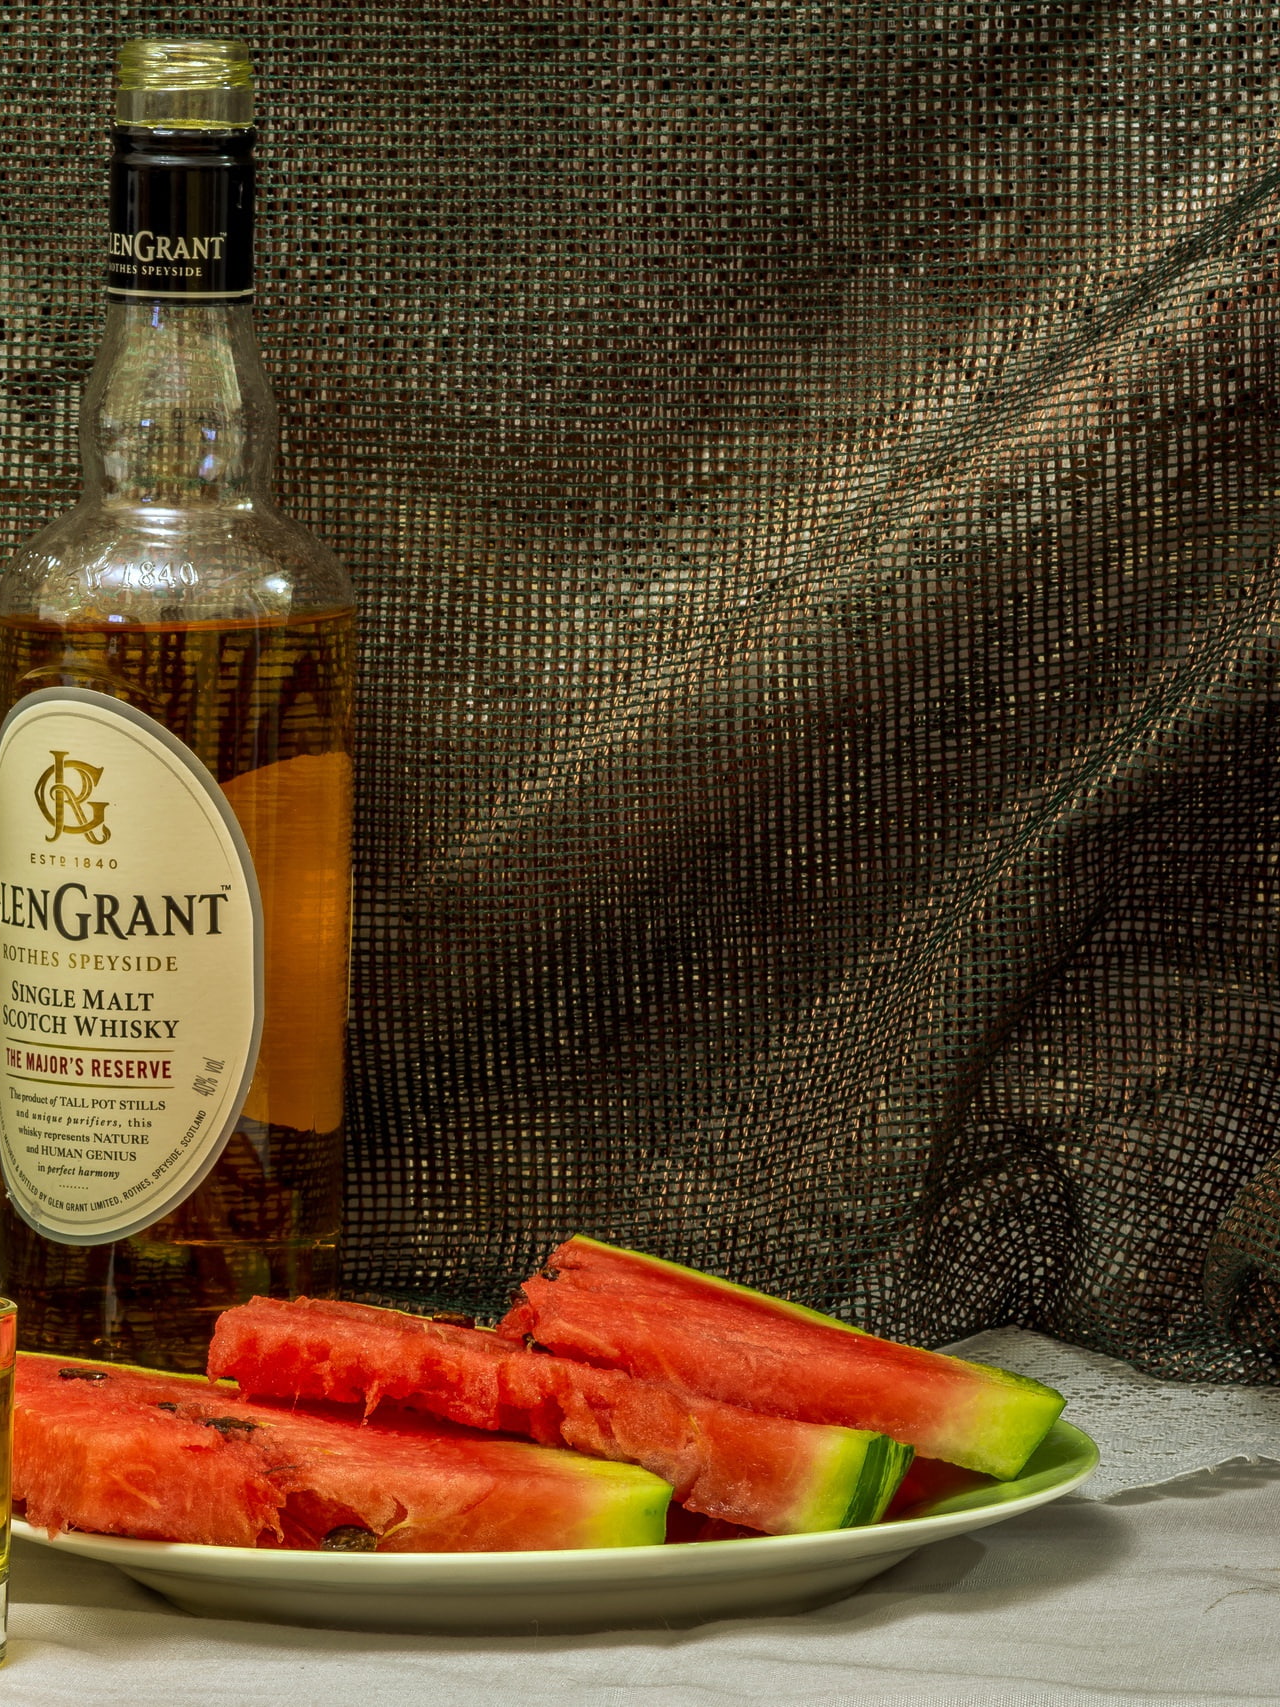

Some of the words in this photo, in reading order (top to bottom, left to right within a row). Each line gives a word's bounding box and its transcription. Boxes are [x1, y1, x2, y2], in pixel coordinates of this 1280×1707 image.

[109, 230, 224, 262] LENGRANT
[109, 263, 137, 275] OTHES
[141, 265, 202, 277] SPEYSIDE
[118, 560, 199, 590] 1840
[74, 856, 119, 870] 1840
[3, 943, 59, 967] ROTHES
[69, 953, 178, 972] SPEYSIDE
[11, 980, 76, 1009] SINGLE
[83, 989, 154, 1012] MALT
[3, 1004, 67, 1035] SCOTCH
[74, 1015, 179, 1039] WHISKY
[6, 1047, 22, 1069] THE
[26, 1051, 84, 1076] MAJOR'S
[91, 1060, 172, 1079] RESERVE
[192, 1075, 218, 1096] 40%
[9, 1086, 21, 1100] The
[21, 1093, 48, 1105] product
[49, 1095, 59, 1107] of
[60, 1096, 89, 1109] TALL
[91, 1098, 116, 1110] POT
[119, 1099, 166, 1111] STILLS
[16, 1109, 29, 1119] and
[32, 1111, 63, 1124] unique
[66, 1115, 122, 1128] purifiers,
[128, 1117, 152, 1128] this
[18, 1125, 41, 1139] whisky
[43, 1130, 91, 1143] represents
[93, 1132, 150, 1145] NATURE
[18, 1170, 39, 1195] BOTTLED
[38, 1191, 48, 1202] BY
[47, 1196, 64, 1210] GLEN
[66, 1202, 88, 1212] GRANT
[180, 1110, 207, 1148] SCOTLAND
[26, 1145, 39, 1154] and
[40, 1145, 83, 1159] HUMAN
[85, 1150, 137, 1161] GENIUS
[38, 1161, 46, 1172] in
[47, 1164, 76, 1176] perfect
[78, 1166, 121, 1180] harmony
